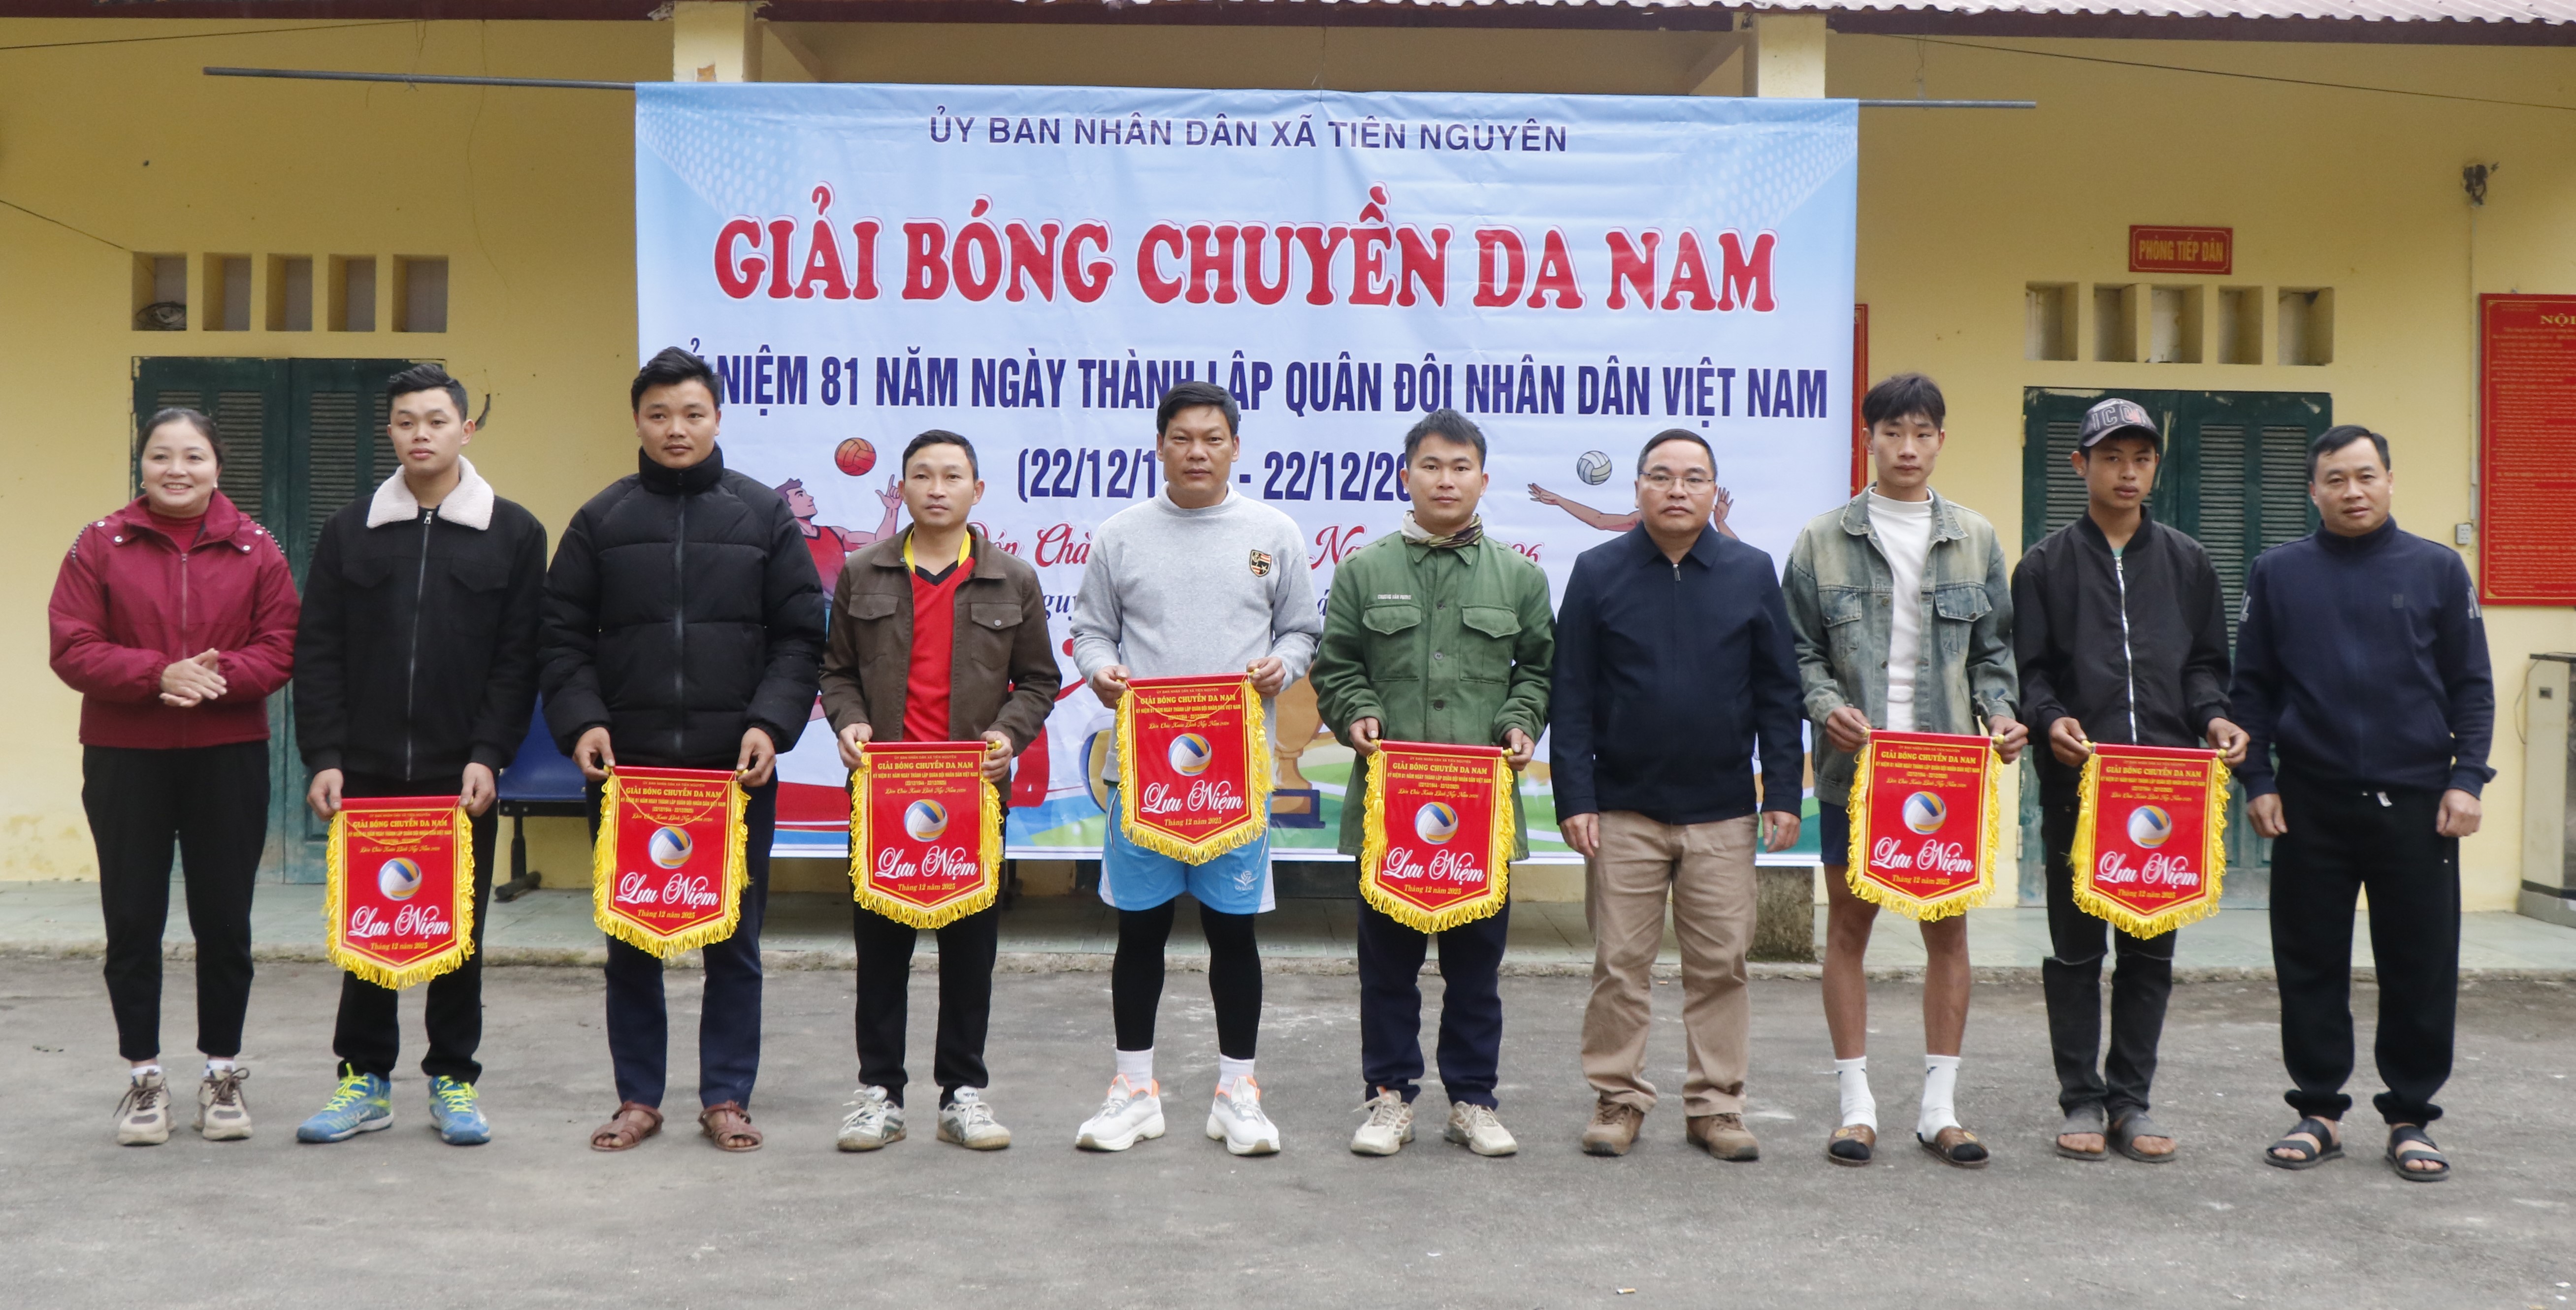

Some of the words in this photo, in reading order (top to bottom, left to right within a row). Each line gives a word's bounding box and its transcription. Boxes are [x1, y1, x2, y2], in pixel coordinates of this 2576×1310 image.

[931, 106, 974, 142] ỦY
[990, 118, 1059, 143] BAN
[1076, 113, 1171, 145] NHÂN
[1187, 113, 1256, 146] DÂN
[1272, 115, 1316, 146] XÃ
[1328, 116, 1404, 148] TIÊN
[1421, 119, 1565, 151] NGUYÊN
[716, 187, 878, 299] GIẢI
[903, 200, 1112, 302] BÓNG
[1139, 188, 1449, 305] CHUYỀN
[1475, 230, 1581, 308] DA
[1607, 233, 1773, 311] NAM
[717, 344, 808, 416] NIỆM
[821, 357, 857, 405] 81
[877, 347, 958, 406] NĂM
[972, 348, 1066, 408] NGÀY
[1286, 351, 1381, 417] QUÂN
[1467, 355, 1564, 415] NHÂN
[1578, 356, 1649, 415] DÂN
[1663, 357, 1735, 427] VIỆT
[1748, 369, 1826, 417] NAM
[1018, 448, 1156, 503] (22/12/1
[1140, 695, 1155, 704] GIẢI
[1157, 695, 1176, 703] BÓNG
[878, 761, 893, 769] GIẢI
[895, 761, 914, 769] BÓNG
[1393, 760, 1408, 769] GIẢI
[1409, 762, 1429, 770] BÓNG
[1141, 782, 1183, 814] Lưu
[1187, 780, 1243, 814] Niệm
[875, 847, 917, 879] Lưu
[921, 845, 978, 880] Niệm
[1382, 847, 1425, 879] Lưu
[1429, 849, 1485, 885] Niệm
[1870, 837, 1913, 869] Lưu
[1917, 839, 1973, 876] Niệm
[2096, 851, 2137, 883] Lưu
[2142, 853, 2197, 889] Niệm
[616, 872, 658, 904] Lưu
[662, 873, 719, 909] Niệm
[1404, 885, 1423, 893] Tháng
[348, 906, 390, 938] Lưu
[394, 904, 450, 939] Niệm
